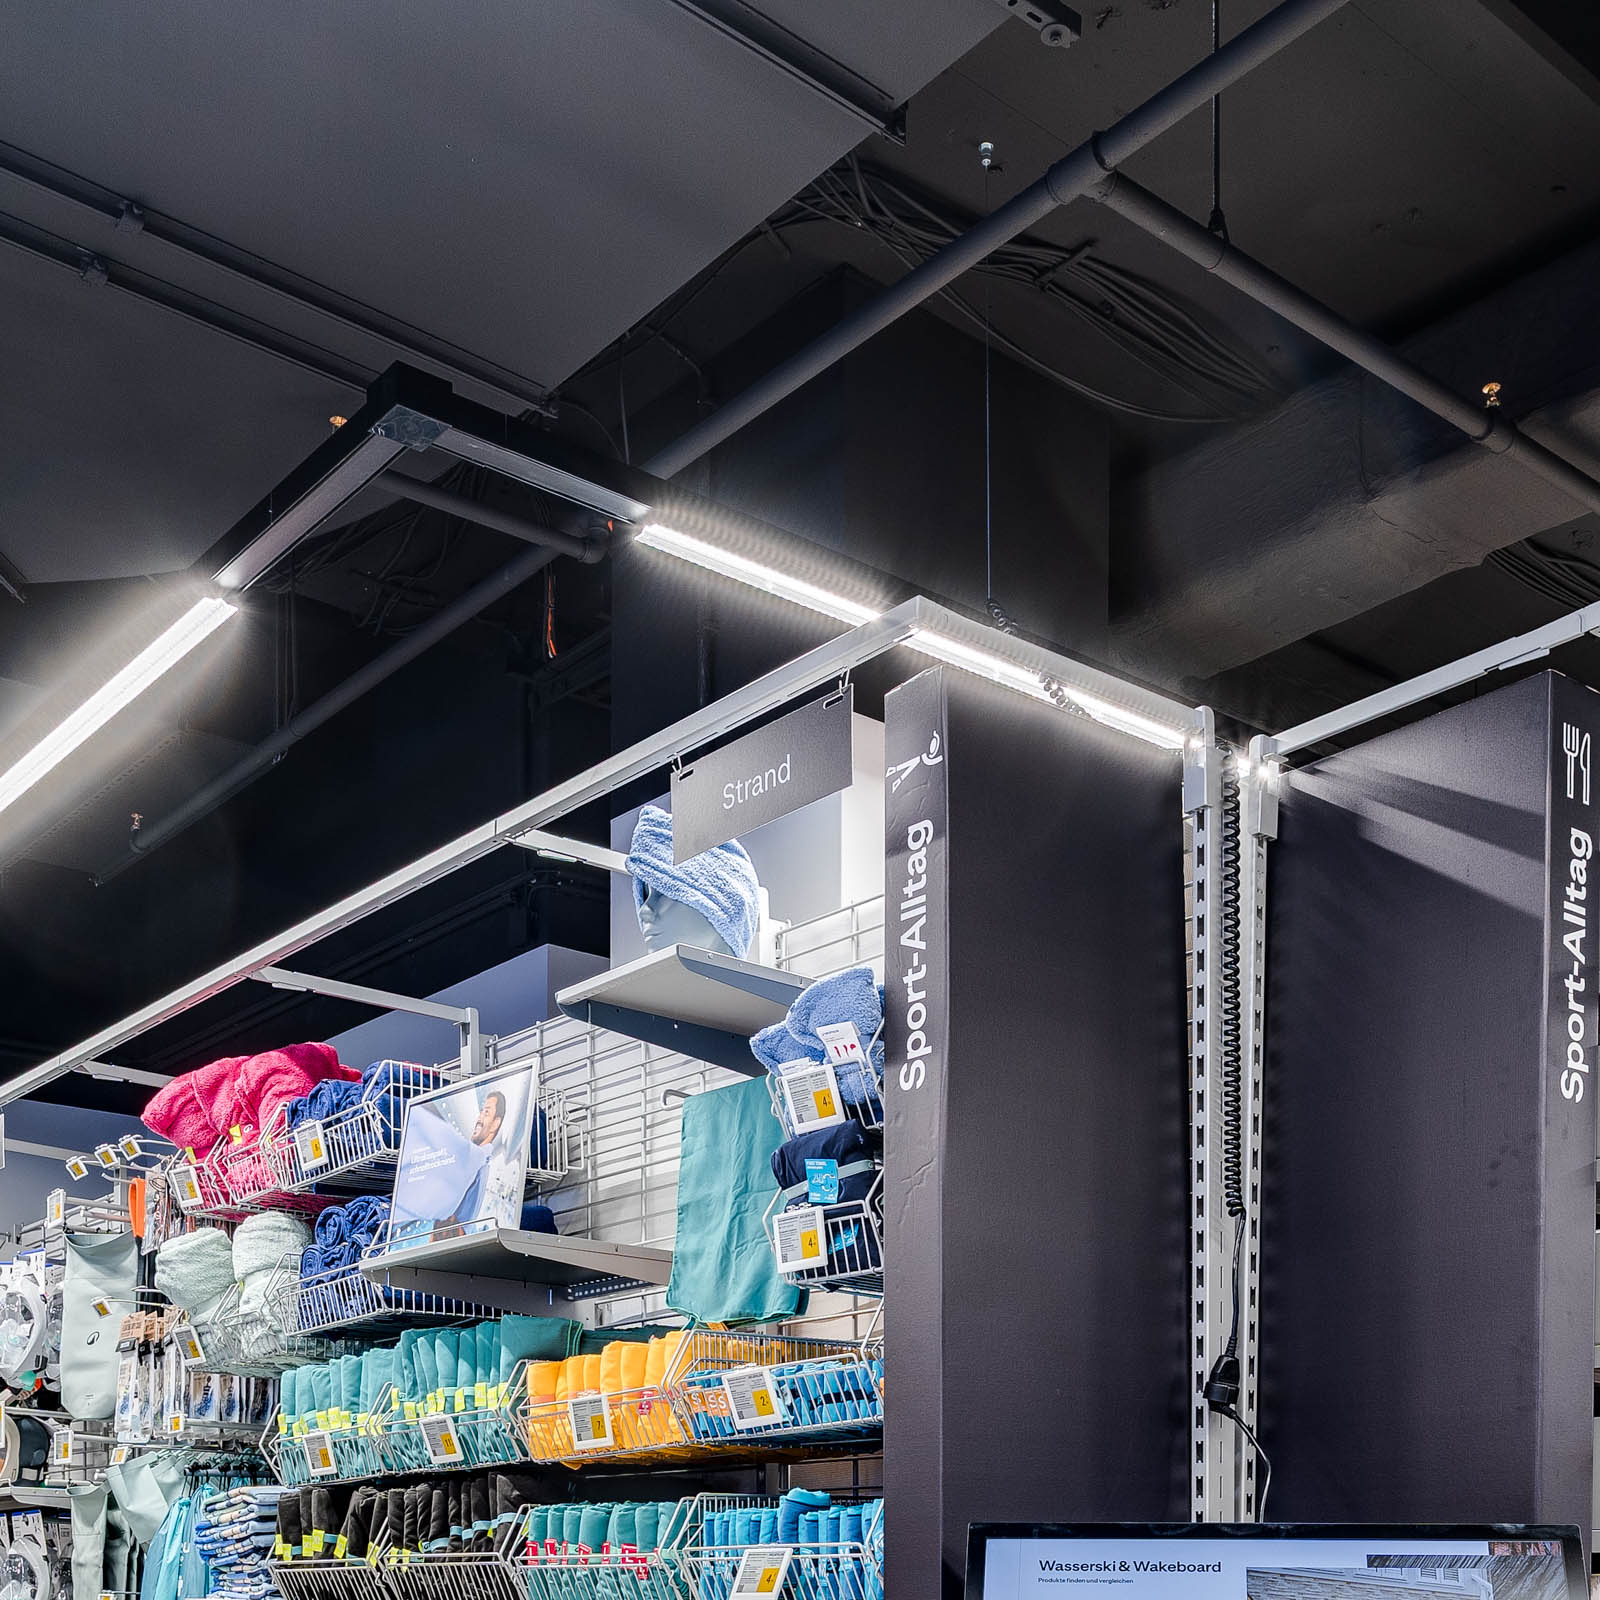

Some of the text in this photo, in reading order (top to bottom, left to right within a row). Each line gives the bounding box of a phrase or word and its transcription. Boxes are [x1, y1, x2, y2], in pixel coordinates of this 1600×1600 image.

[722, 754, 792, 810] Strand
[899, 818, 934, 1092] Sport-Alltag
[1561, 826, 1593, 1105] Sport-Alltag
[1038, 1559, 1222, 1573] Wasserski & Wakeboard
[1086, 1577, 1099, 1585] und
[1099, 1577, 1134, 1586] vergleichen
